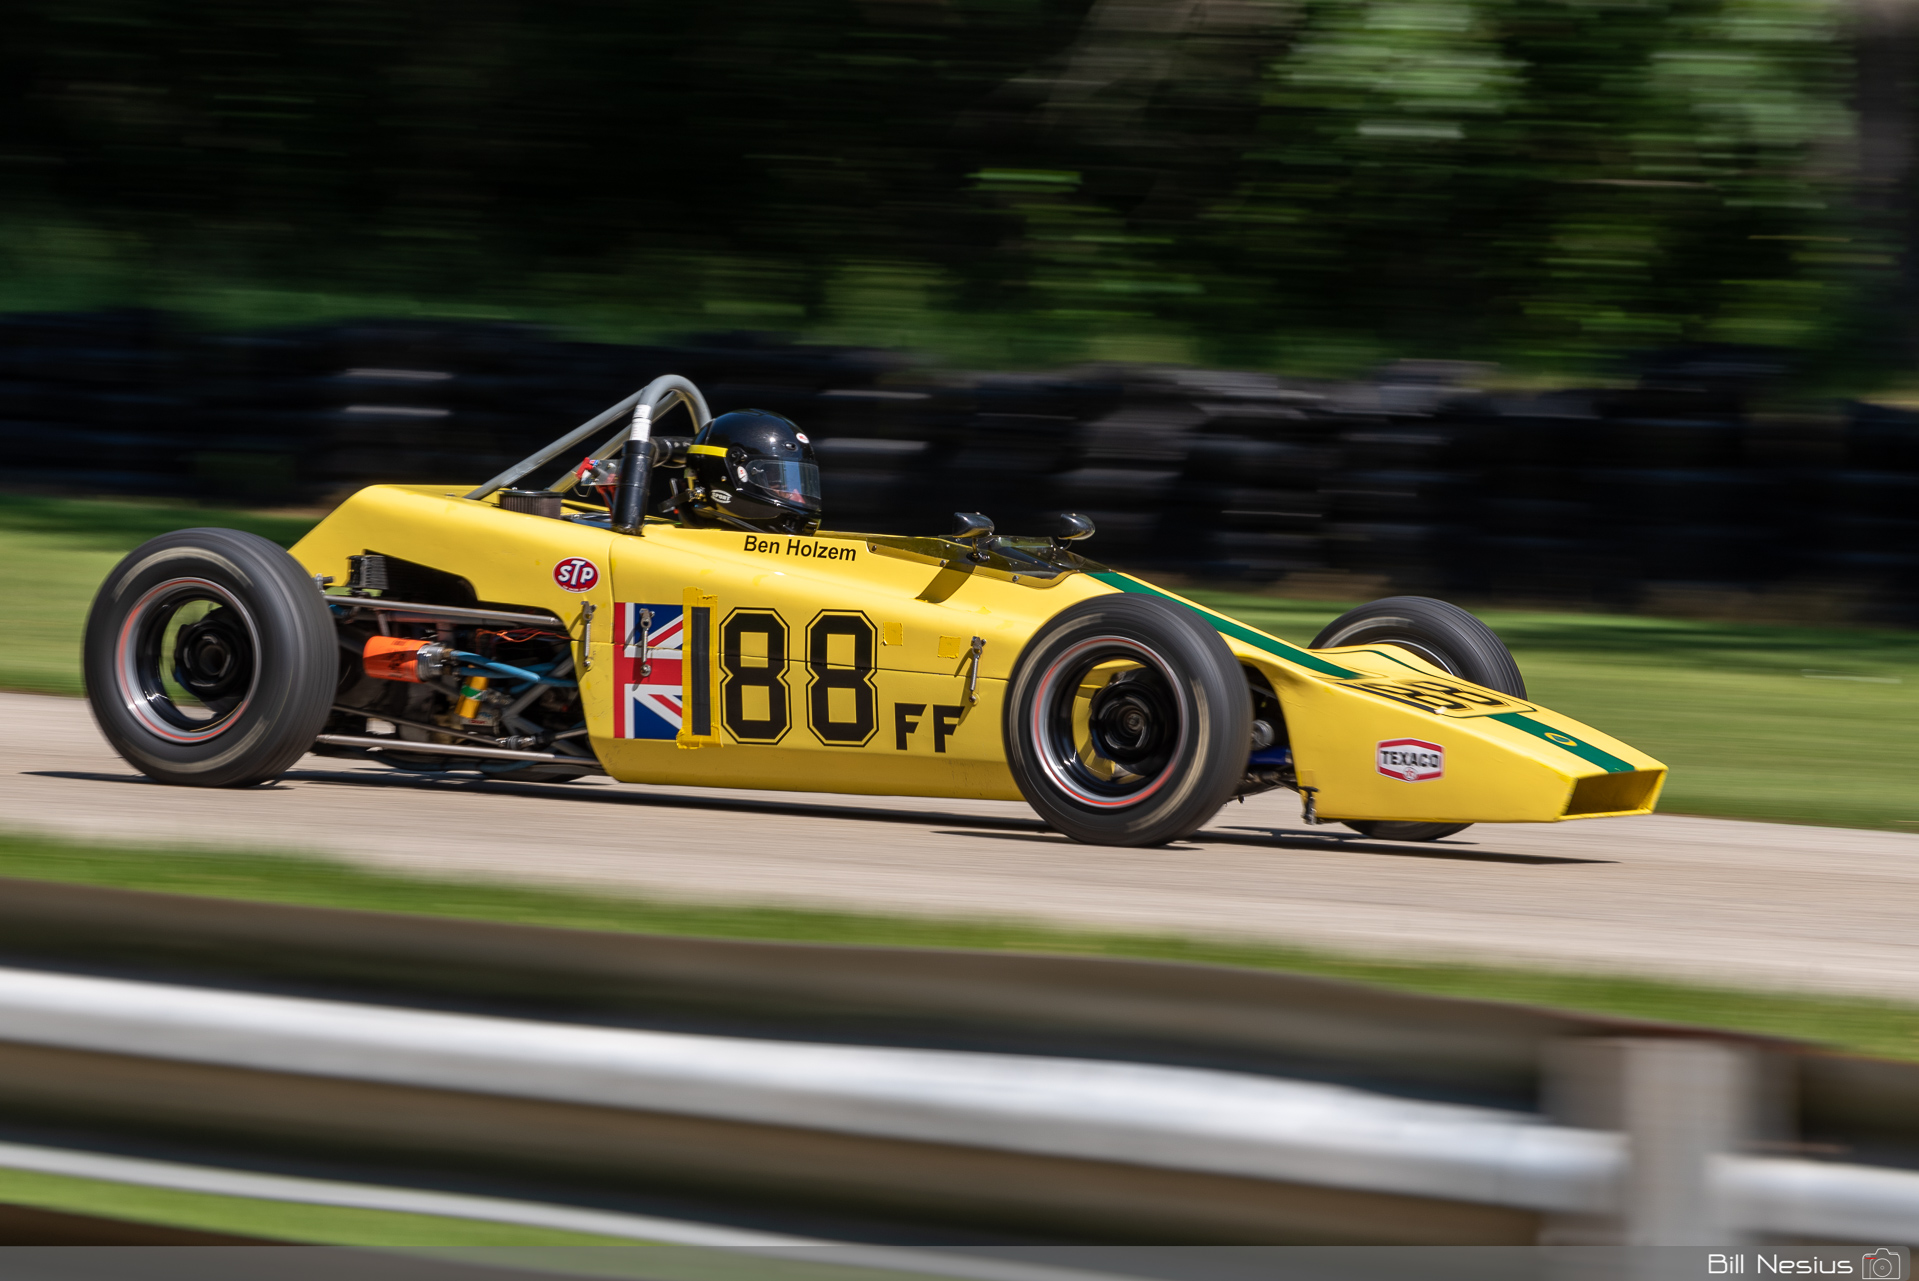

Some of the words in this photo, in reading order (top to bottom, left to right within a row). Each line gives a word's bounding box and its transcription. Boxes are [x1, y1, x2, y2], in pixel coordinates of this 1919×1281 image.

[744, 535, 780, 554] Ben
[786, 538, 857, 561] Holzem
[557, 559, 594, 586] STP
[691, 606, 880, 747] 188
[894, 702, 966, 754] FF
[1380, 750, 1439, 768] TEXACO
